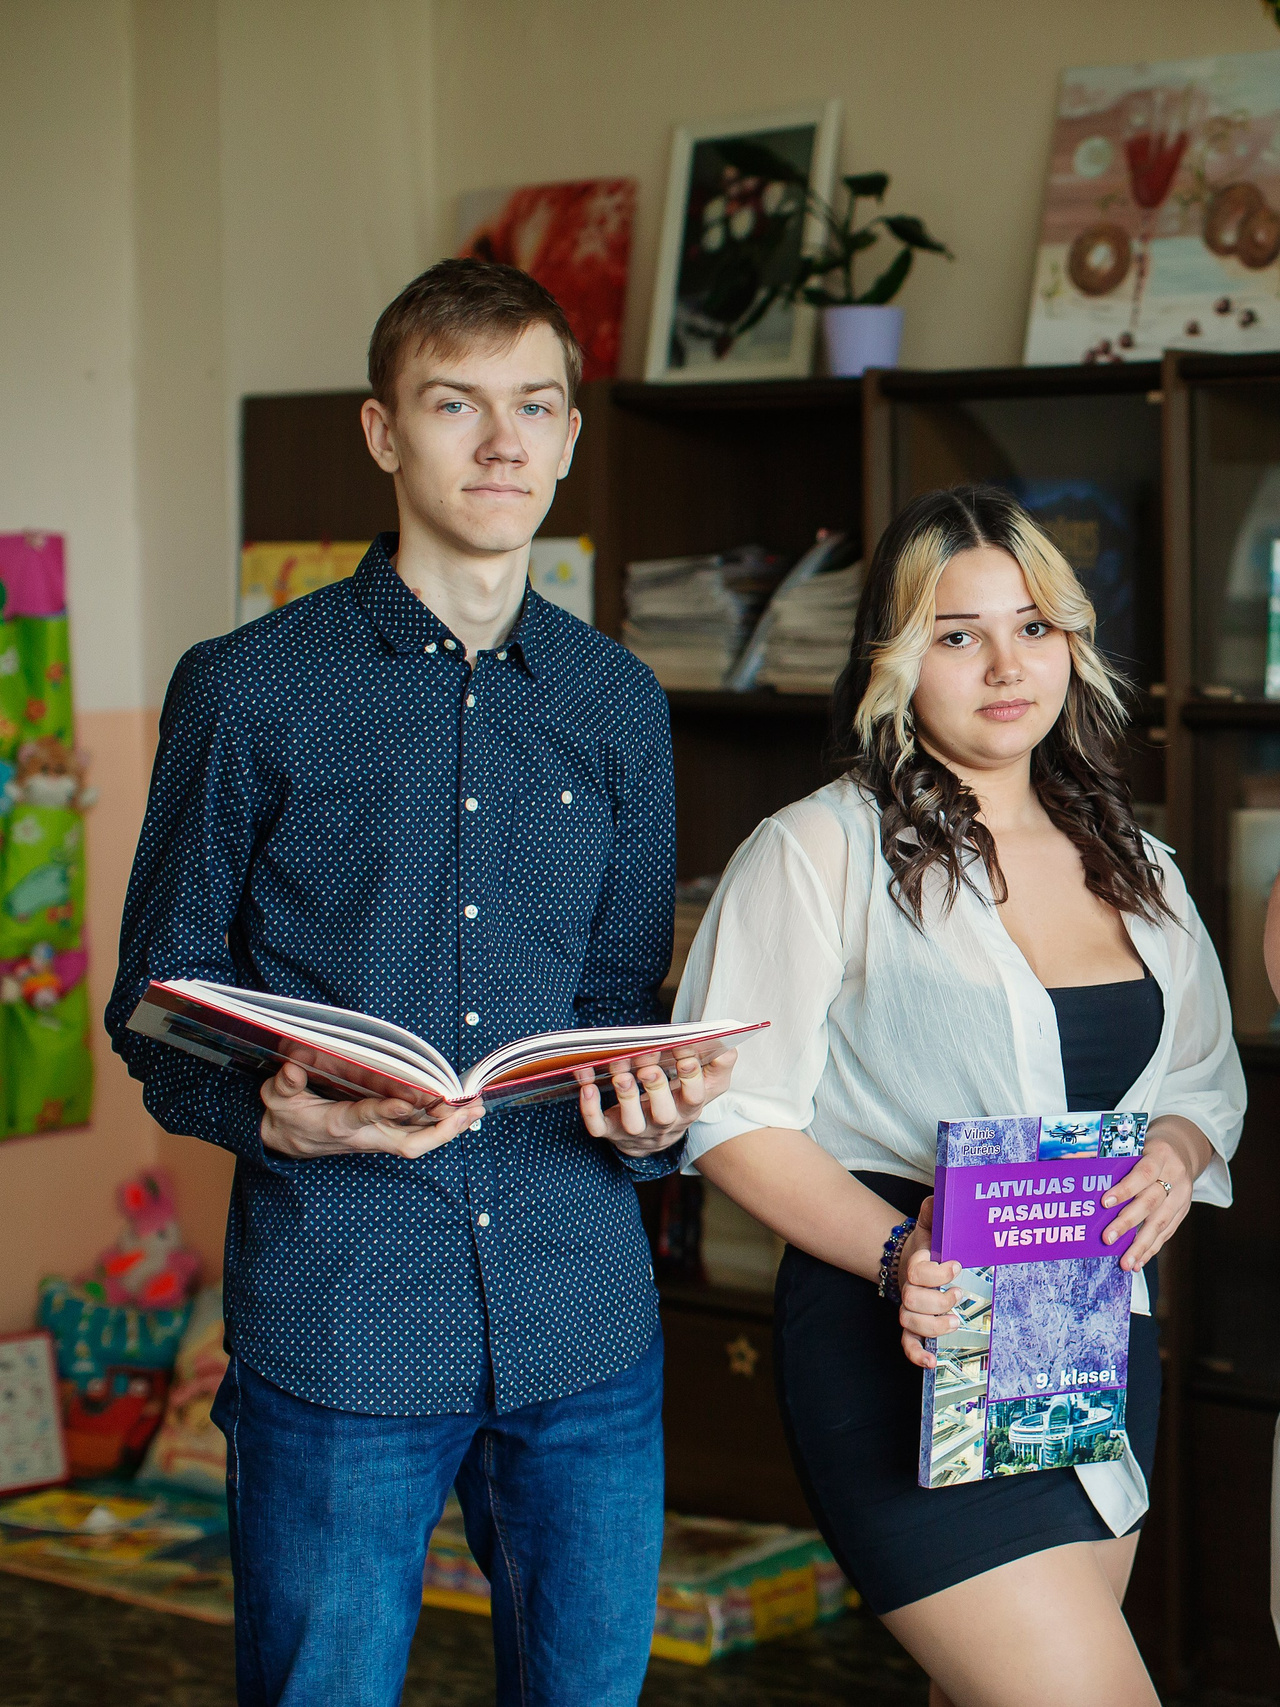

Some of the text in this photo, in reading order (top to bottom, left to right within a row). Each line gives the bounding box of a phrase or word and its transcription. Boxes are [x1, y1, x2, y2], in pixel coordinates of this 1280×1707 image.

[963, 1128, 995, 1140] Vilnis
[962, 1143, 1001, 1156] Purēns
[975, 1174, 1113, 1200] LATVIJAS UN
[988, 1200, 1096, 1224] PASAULES
[993, 1225, 1086, 1248] VĒSTURE
[1036, 1365, 1116, 1389] 9. klasei
